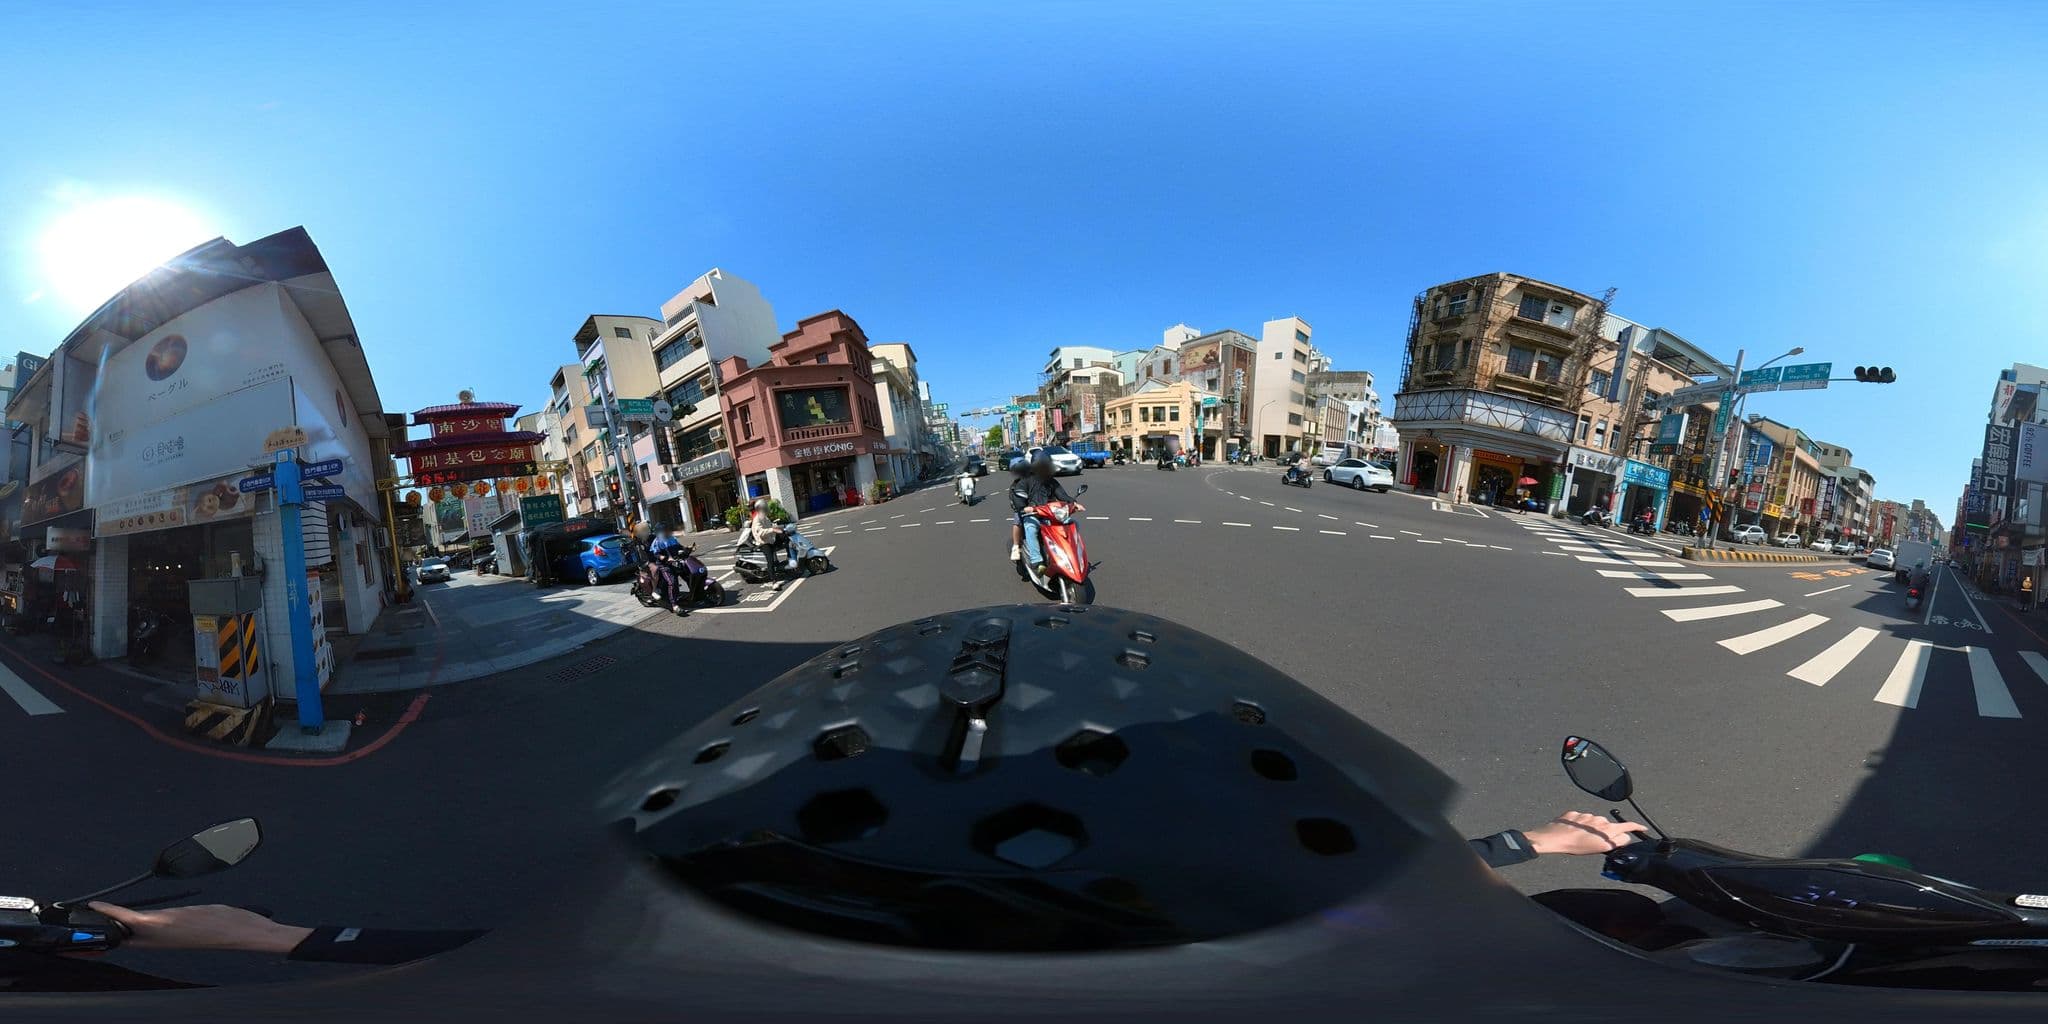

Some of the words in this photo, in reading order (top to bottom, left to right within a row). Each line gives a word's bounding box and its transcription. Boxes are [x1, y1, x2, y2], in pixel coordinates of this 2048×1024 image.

[823, 442, 854, 455] KÖNIG
[420, 447, 526, 469] 開基包公廟
